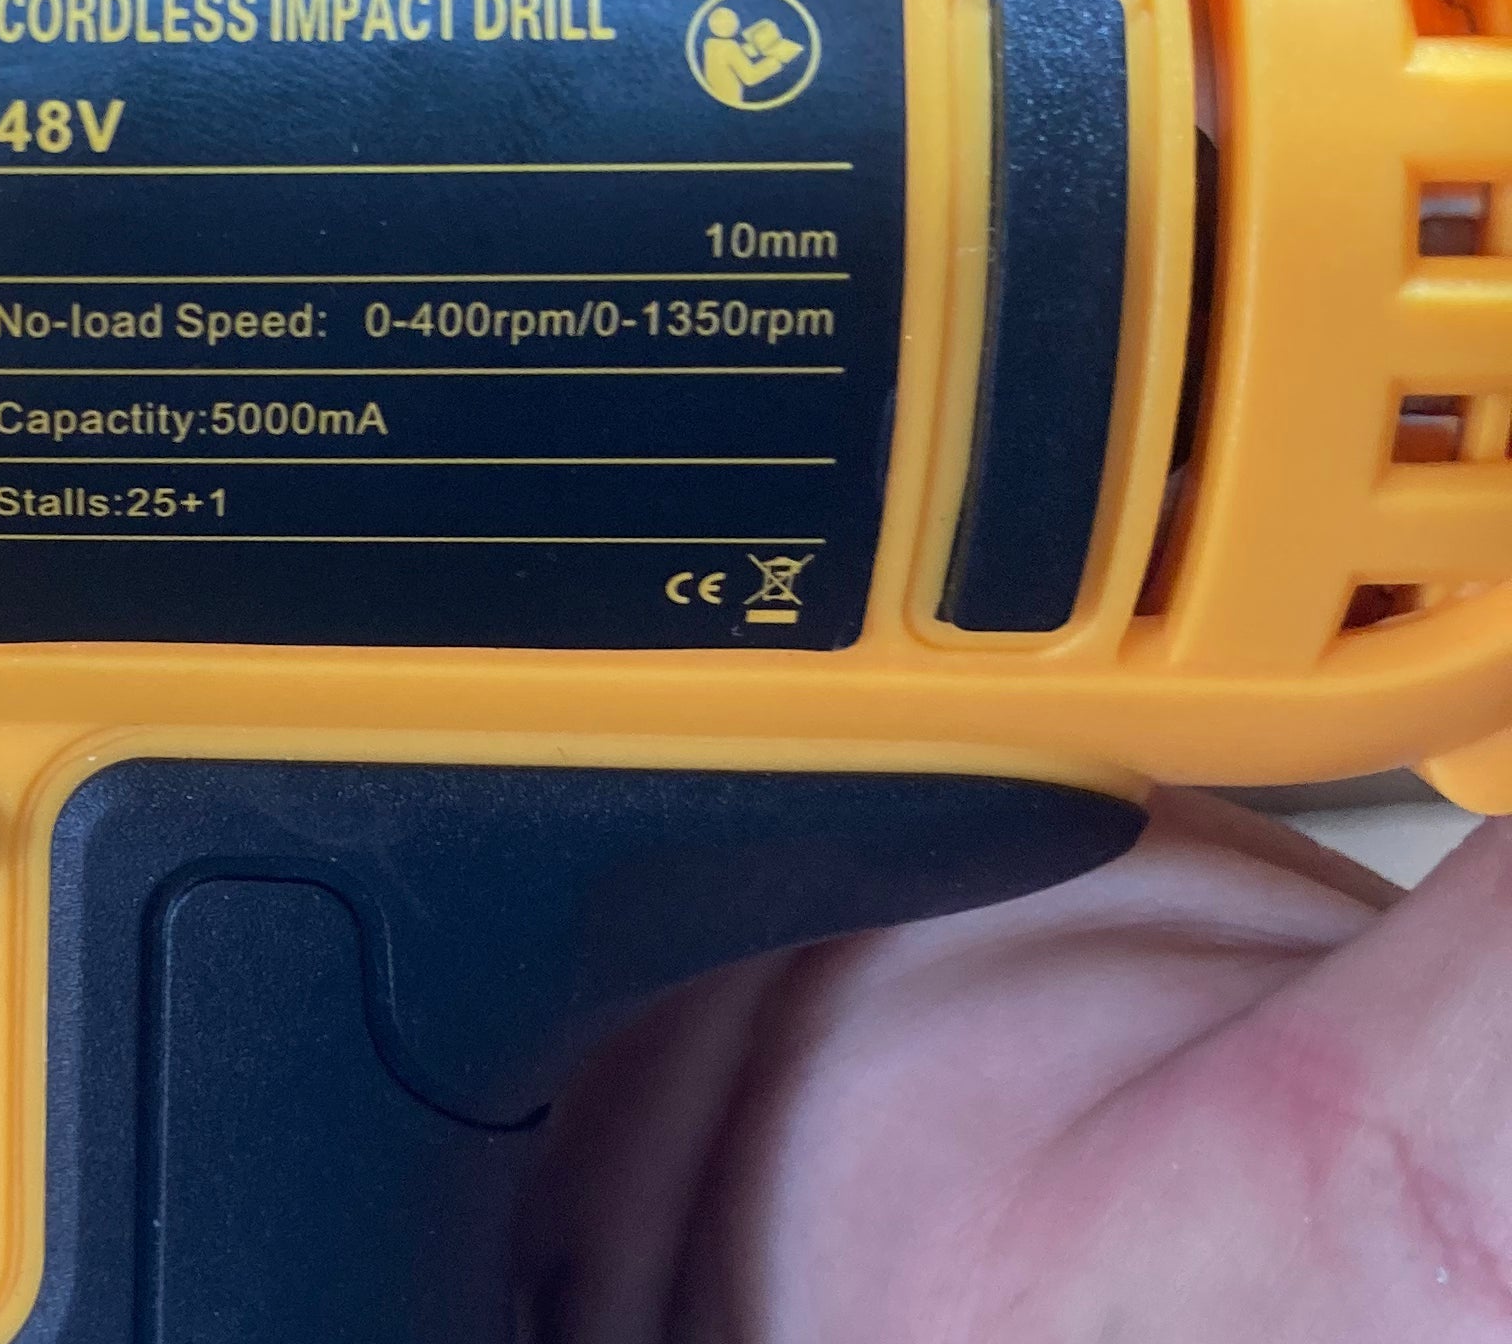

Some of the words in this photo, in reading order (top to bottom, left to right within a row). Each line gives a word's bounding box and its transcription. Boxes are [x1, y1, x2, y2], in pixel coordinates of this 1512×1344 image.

[705, 222, 839, 260] 10mm
[175, 302, 329, 347] Speed:
[365, 300, 836, 347] 0-400rpm/0-1350rpm
